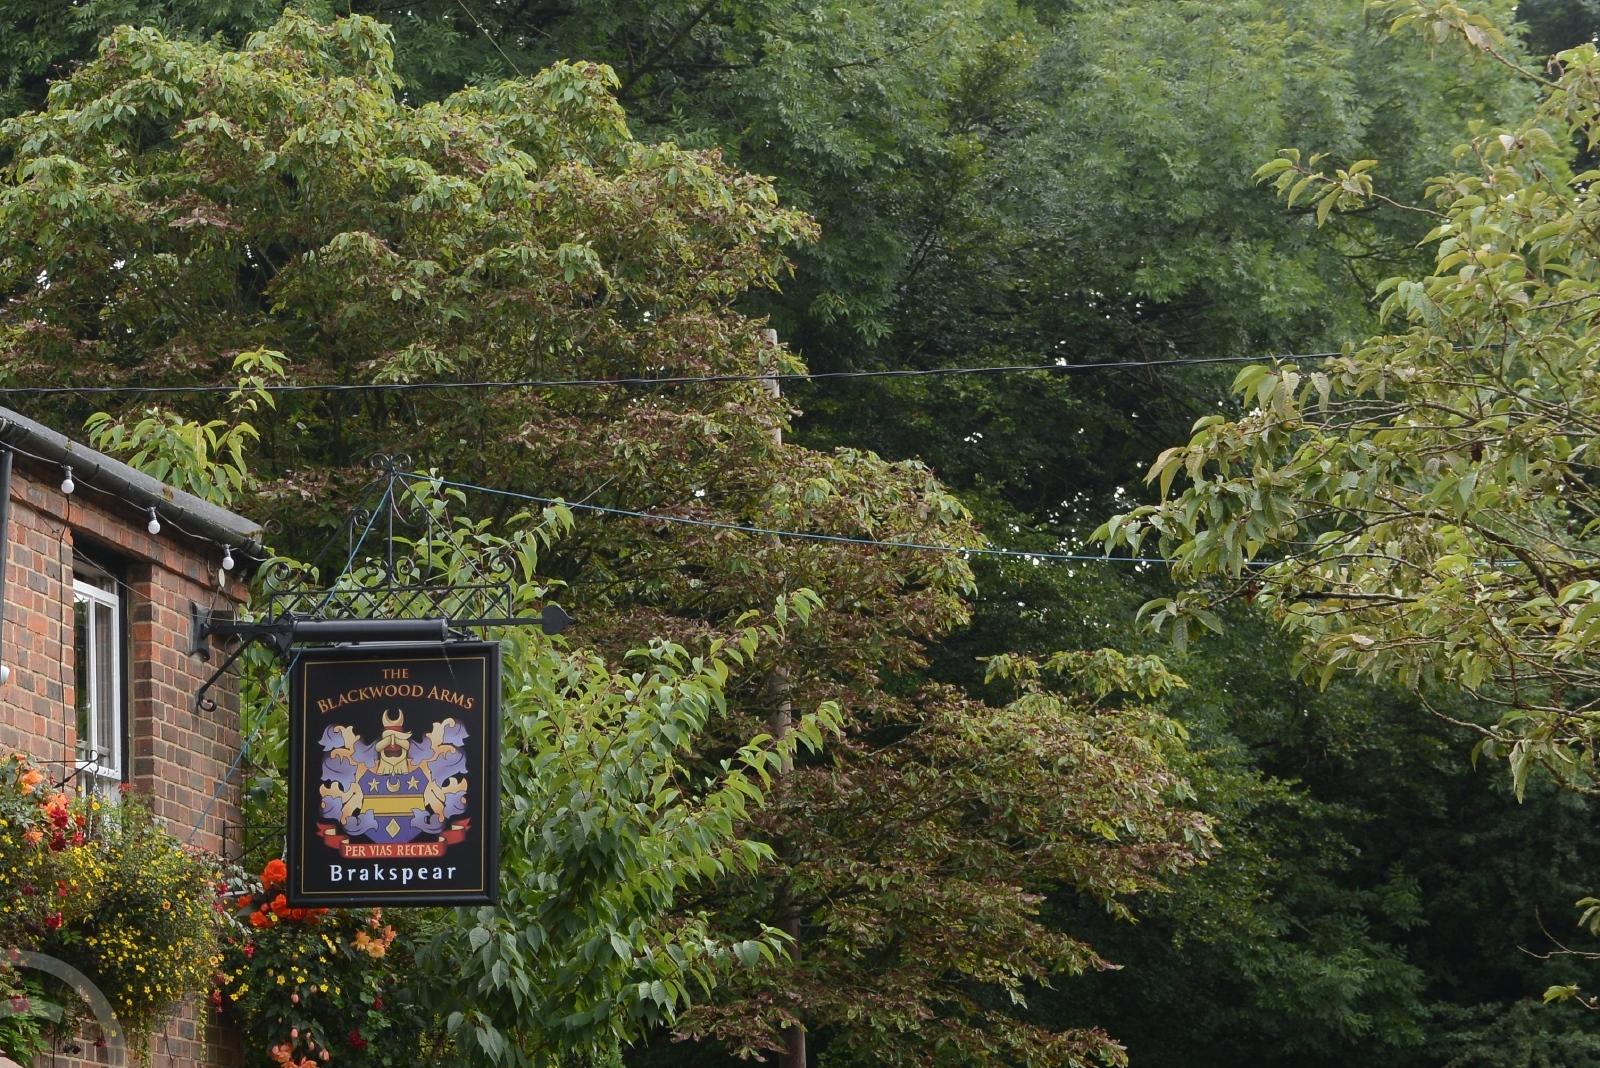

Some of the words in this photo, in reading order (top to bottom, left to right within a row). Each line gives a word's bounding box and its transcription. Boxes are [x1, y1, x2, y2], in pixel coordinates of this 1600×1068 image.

[381, 668, 409, 679] THE
[317, 684, 424, 714] BLACKWOOD
[427, 685, 474, 710] ARMS
[345, 845, 366, 857] PER
[369, 845, 392, 856] VIAS
[397, 844, 439, 856] RECTAS
[329, 863, 457, 885] Brakspear
